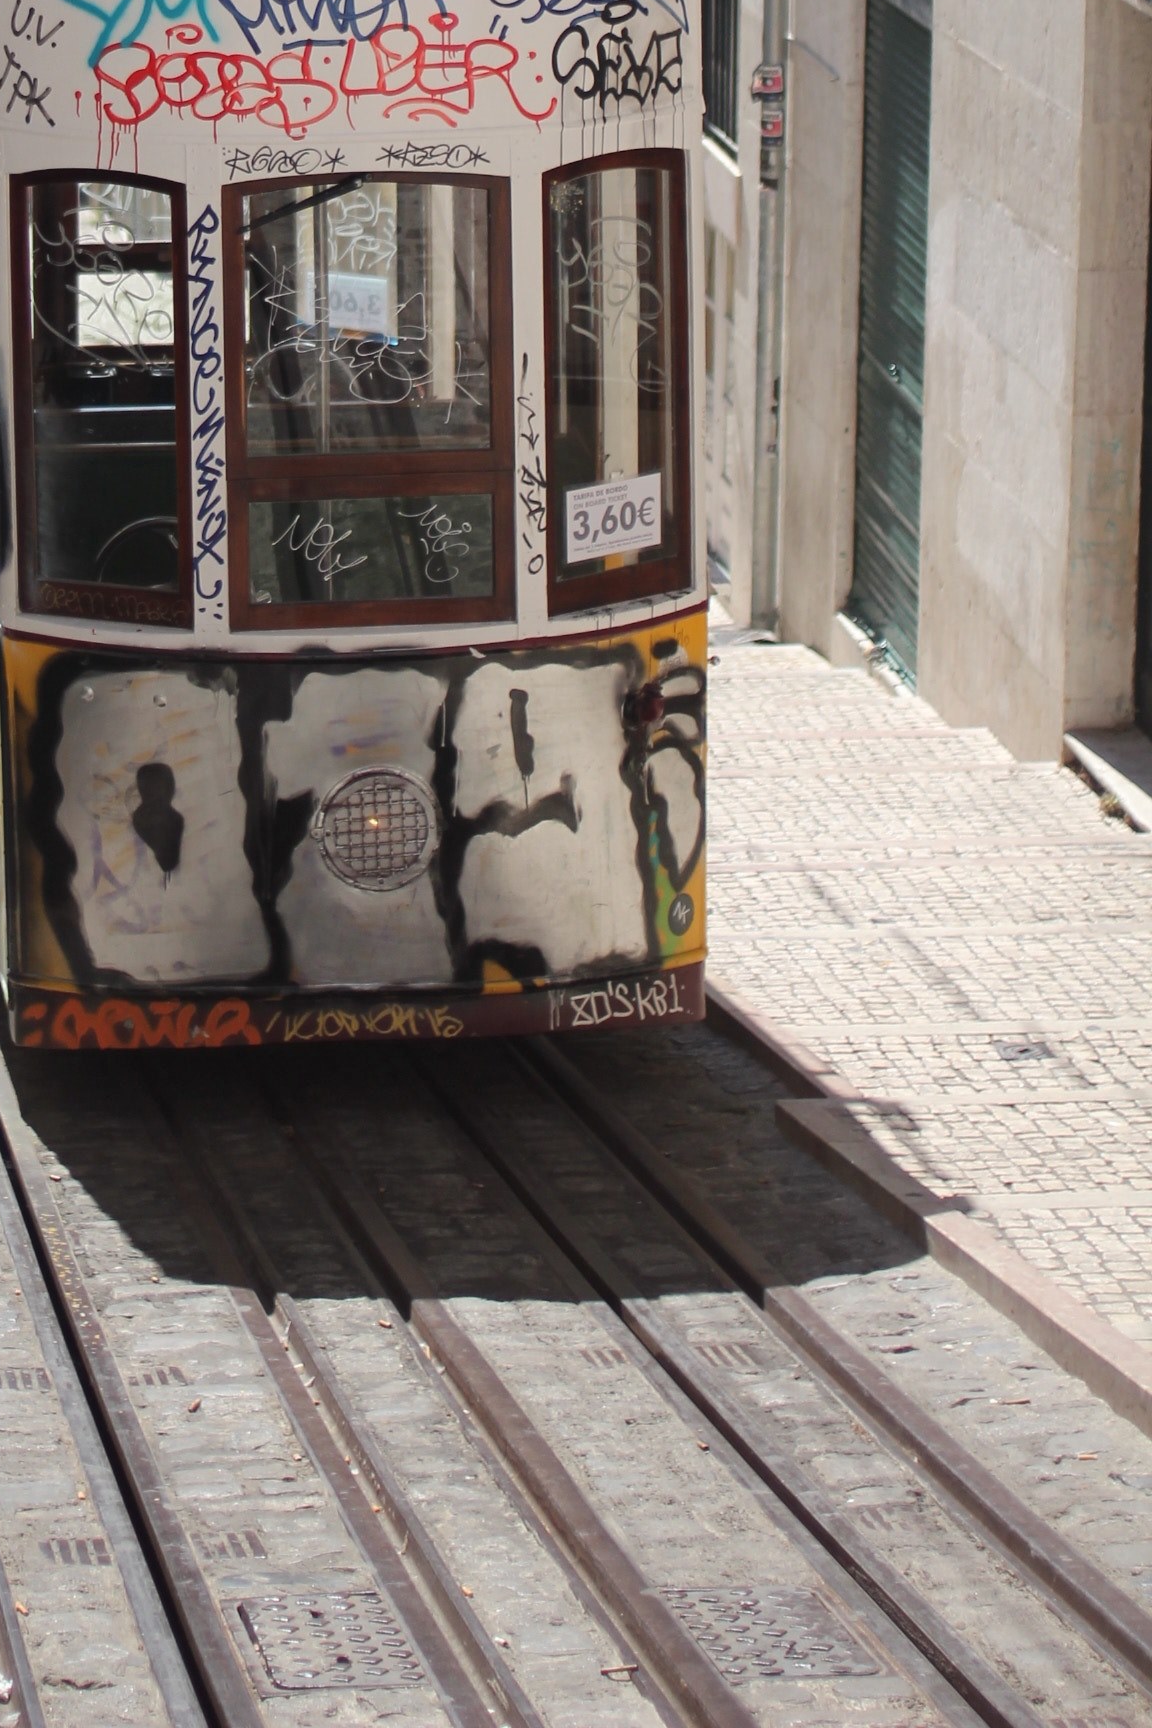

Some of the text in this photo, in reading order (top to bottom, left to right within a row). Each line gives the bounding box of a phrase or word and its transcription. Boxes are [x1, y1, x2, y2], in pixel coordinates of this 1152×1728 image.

[573, 492, 594, 501] TARIFA
[606, 484, 628, 495] BORDO
[573, 493, 628, 510] ON BOARD TICKET
[573, 496, 656, 543] 3,60€
